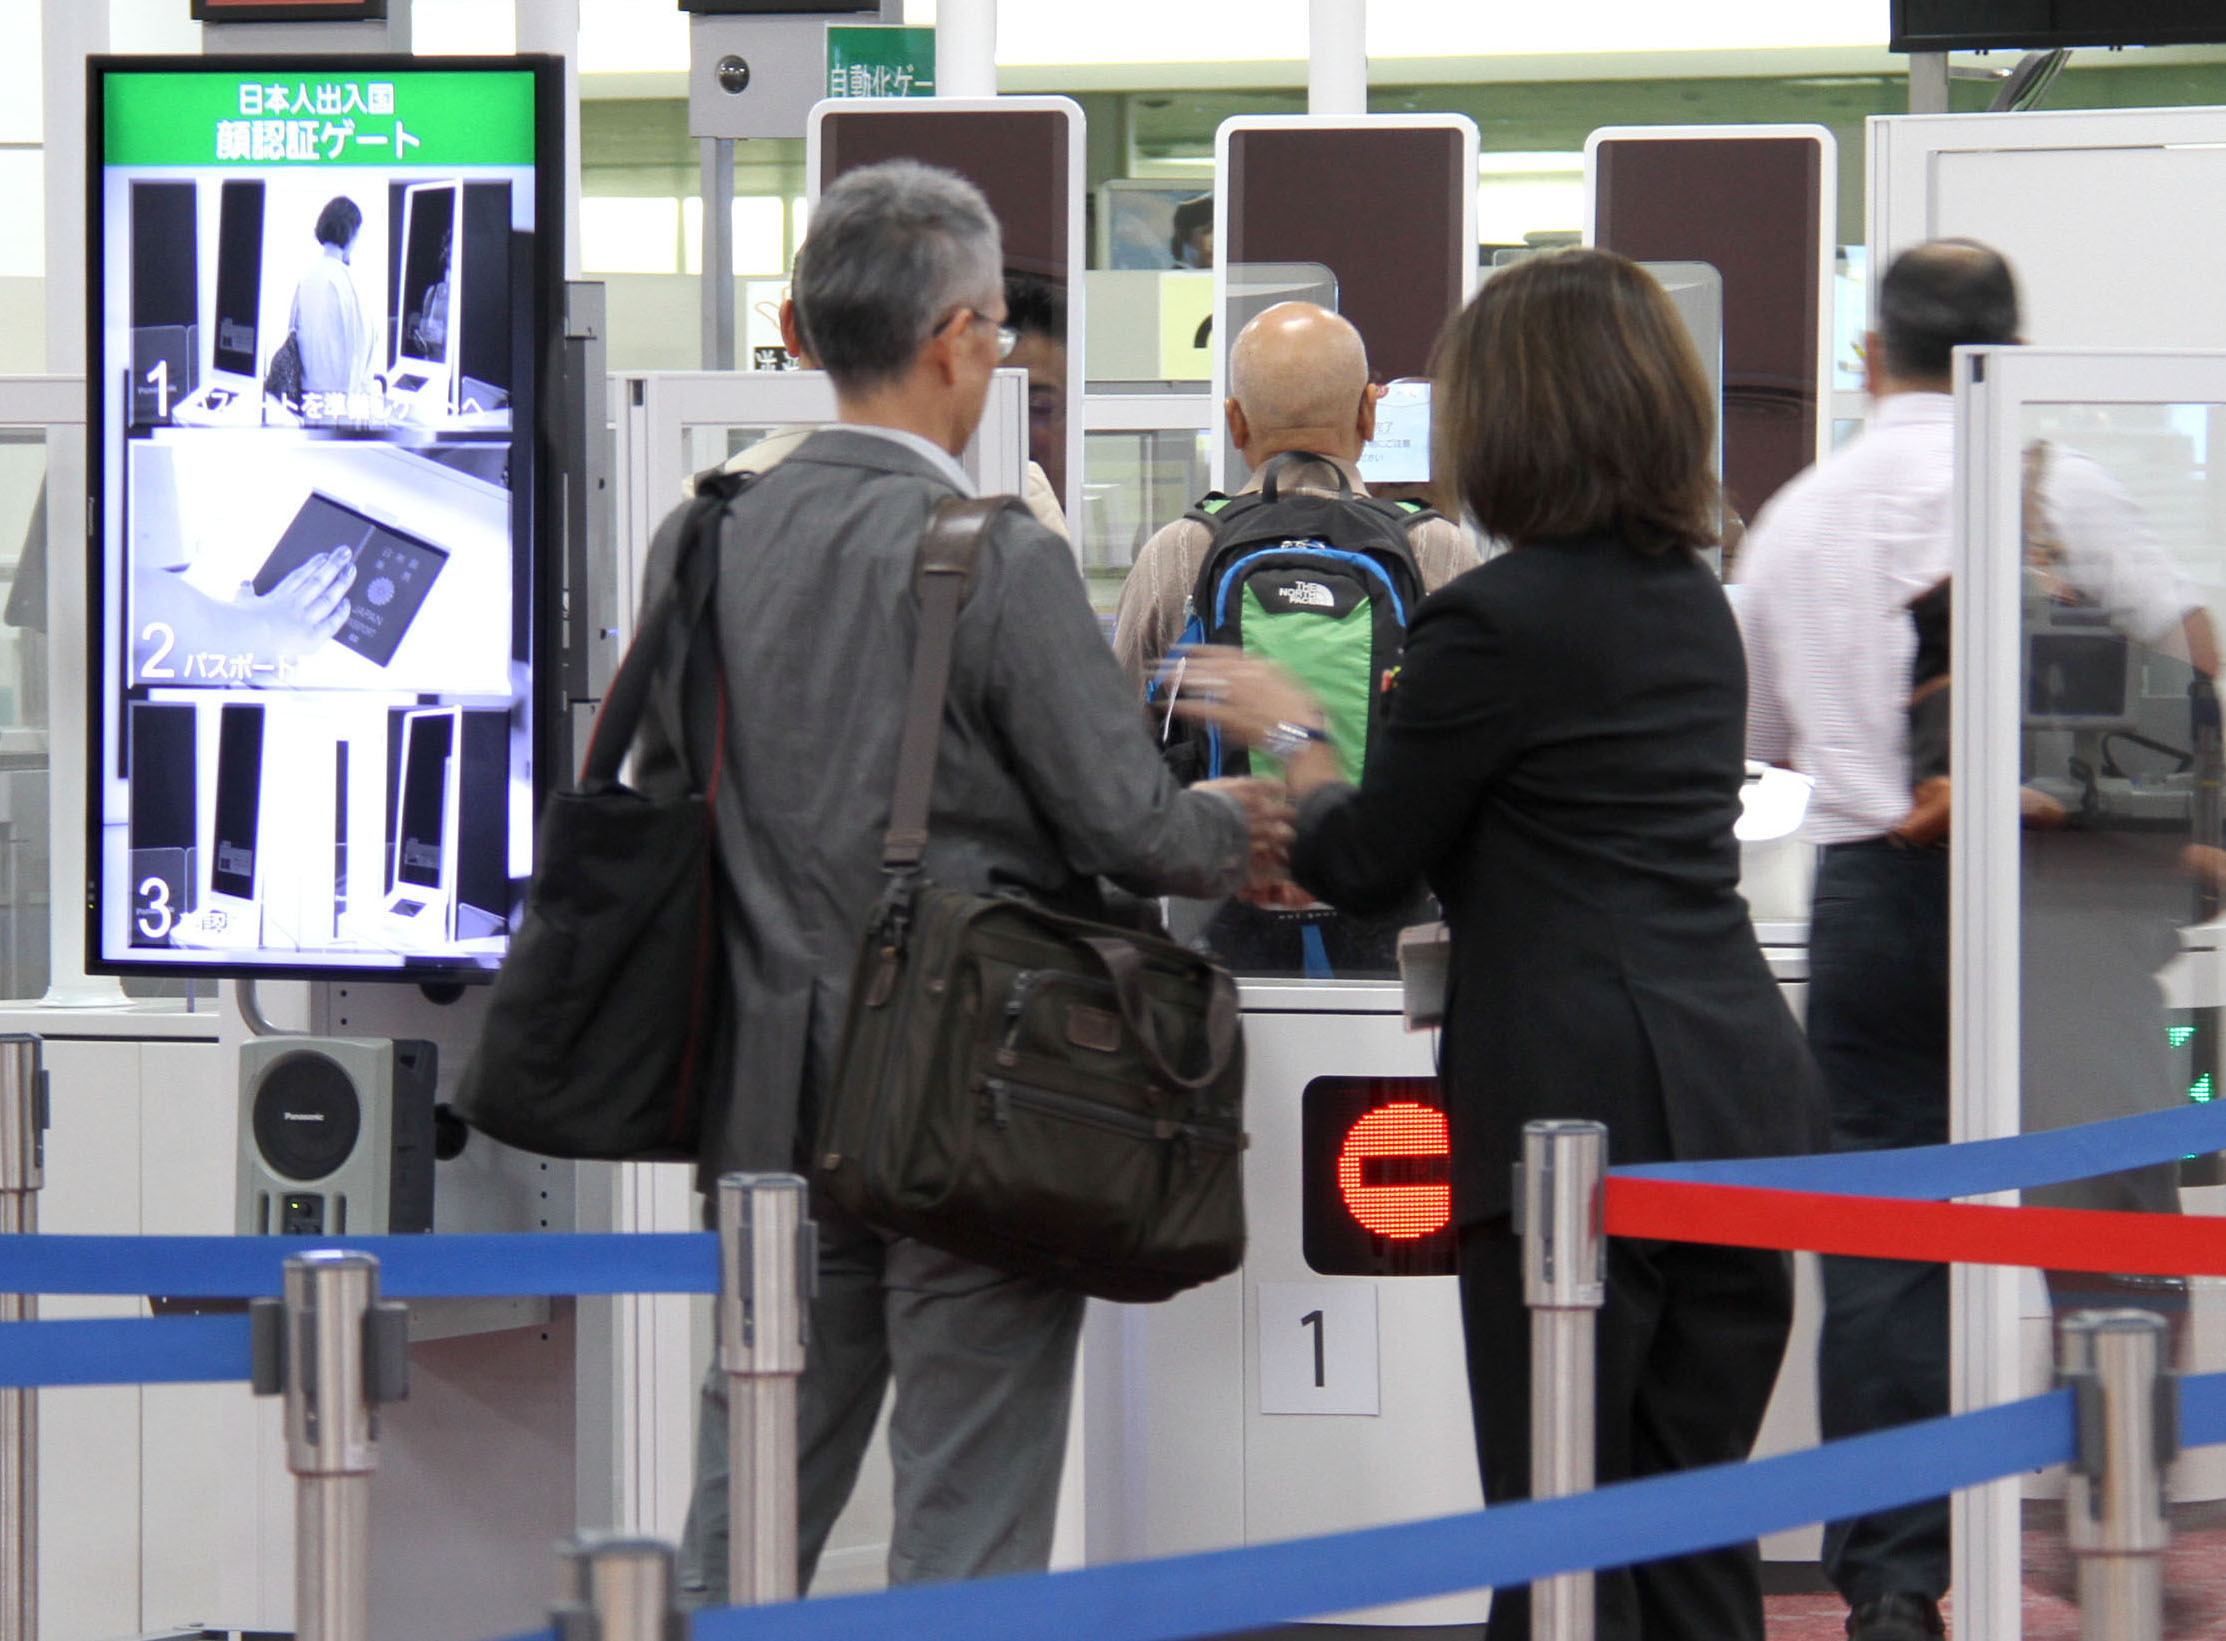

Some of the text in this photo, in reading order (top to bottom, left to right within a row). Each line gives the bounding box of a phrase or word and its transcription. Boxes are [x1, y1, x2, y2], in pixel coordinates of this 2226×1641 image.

[239, 82, 395, 115] 日本人出入国
[216, 118, 420, 160] 顔認証ゲート
[146, 359, 168, 417] 1
[1279, 587, 1317, 599] NORTH
[1289, 596, 1317, 606] FACE
[1295, 580, 1317, 591] THE
[141, 622, 175, 678] 2
[138, 876, 172, 938] 3
[1301, 1310, 1325, 1388] 1
